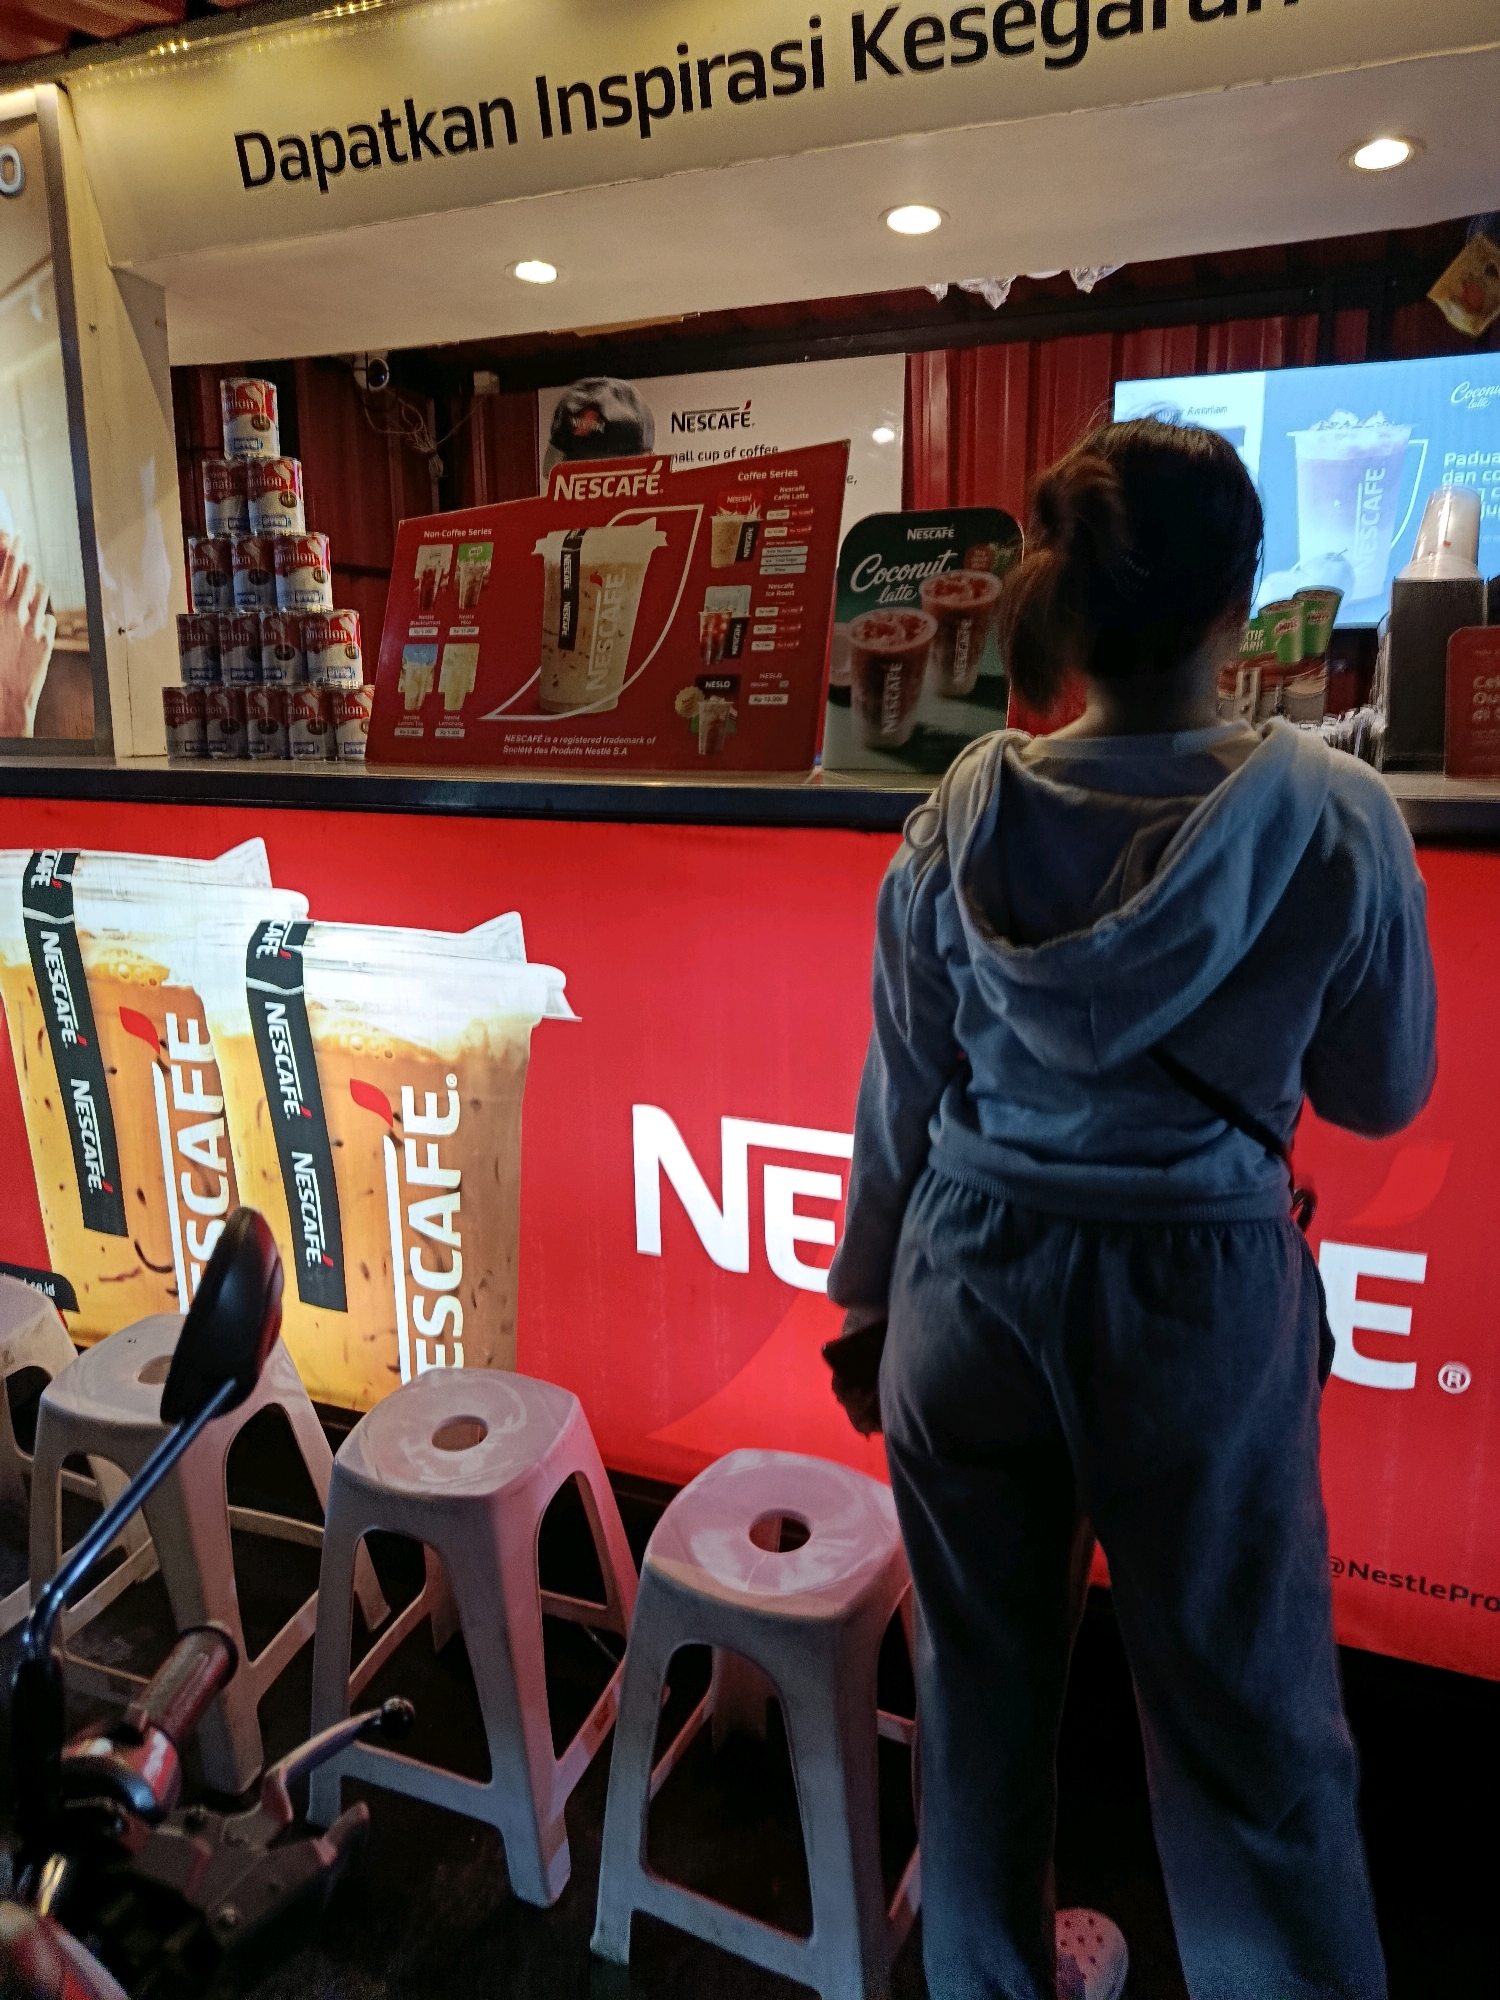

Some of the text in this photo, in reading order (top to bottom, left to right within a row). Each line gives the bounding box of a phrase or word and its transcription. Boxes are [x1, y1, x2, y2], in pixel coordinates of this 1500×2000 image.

[233, 95, 519, 193] Dapatkan
[534, 16, 826, 140] Inspirasi
[671, 400, 753, 433] NESCAFÉ
[698, 450, 720, 462] cup
[723, 446, 737, 460] of
[554, 461, 664, 502] NESCAFÉ
[738, 468, 799, 482] Coffee Series
[1442, 470, 1476, 484] dan
[791, 491, 810, 500] Latte
[468, 527, 493, 536] Series
[907, 523, 955, 541] NESCAFÉ
[562, 553, 573, 591] NESCAFÉ
[849, 549, 959, 593] Coconut
[875, 584, 918, 604] latte
[561, 601, 572, 637] NESCAFÉ
[586, 568, 627, 692] NESCAFÉ
[705, 680, 731, 689] NESLO
[503, 744, 533, 754] Société
[534, 746, 549, 755] des
[550, 745, 584, 755] Produits
[585, 745, 612, 755] Nestlé
[504, 733, 543, 743] NESCAFÉ
[544, 735, 551, 743] is
[560, 735, 602, 746] registered
[603, 735, 645, 744] trademark
[646, 735, 657, 745] of
[41, 930, 89, 1049] NESCAFÉ
[265, 1001, 313, 1121] NESCAFÉ
[70, 1077, 114, 1195] NESCAFÉ
[291, 1151, 334, 1269] NESCAFÉ
